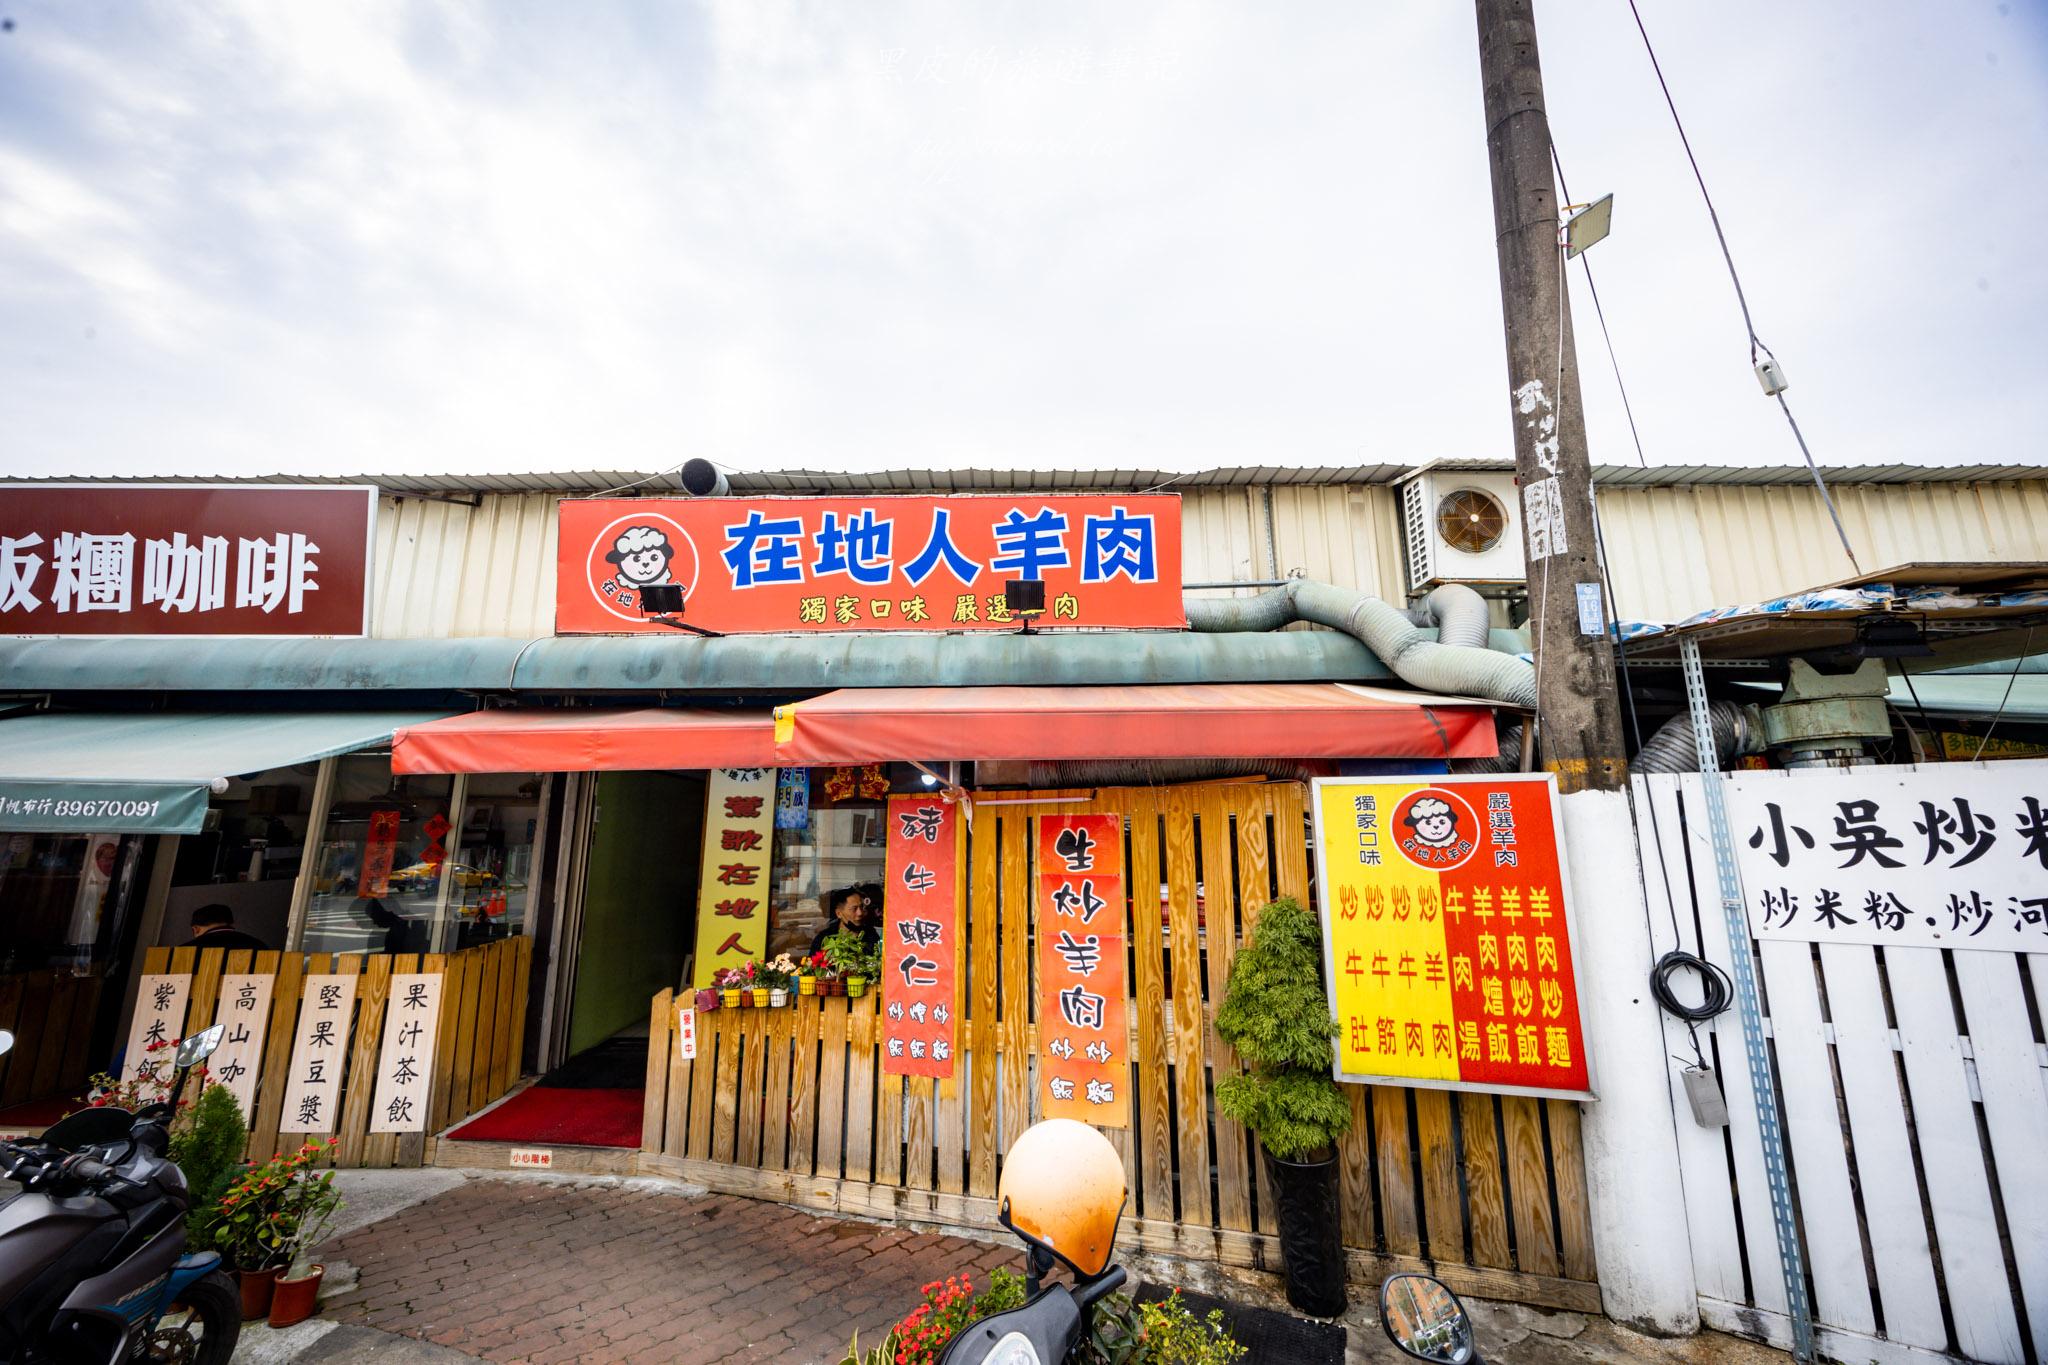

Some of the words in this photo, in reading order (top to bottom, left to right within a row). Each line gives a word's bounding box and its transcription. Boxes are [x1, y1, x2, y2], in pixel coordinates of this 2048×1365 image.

[722, 505, 1159, 589] 在地人羊肉
[800, 595, 930, 623] 獨家口味
[952, 593, 1079, 623] 嚴選肉
[0, 796, 53, 816] 帆布行
[54, 800, 160, 817] 89670091
[1354, 794, 1382, 866] 獨家口味
[1403, 838, 1472, 863] 在地人羊肉
[1487, 792, 1519, 868] 嚴選羊肉
[1051, 827, 1107, 1030] 生炒羊肉
[1338, 884, 1370, 1054] 炒牛肚
[1364, 884, 1398, 1056] 炒牛筋
[1391, 884, 1425, 1058] 炒牛肉
[1417, 884, 1453, 1060] 炒羊肉
[1445, 885, 1481, 1062] 牛肉湯
[1472, 885, 1512, 1064] 羊肉燴飯
[1500, 885, 1542, 1066] 羊肉炒飯
[1529, 886, 1572, 1068] 羊肉炒麵
[135, 983, 176, 1106] 紫米飯
[297, 985, 343, 1125] 堅果豆漿
[386, 983, 428, 1123] 果汁茶飲
